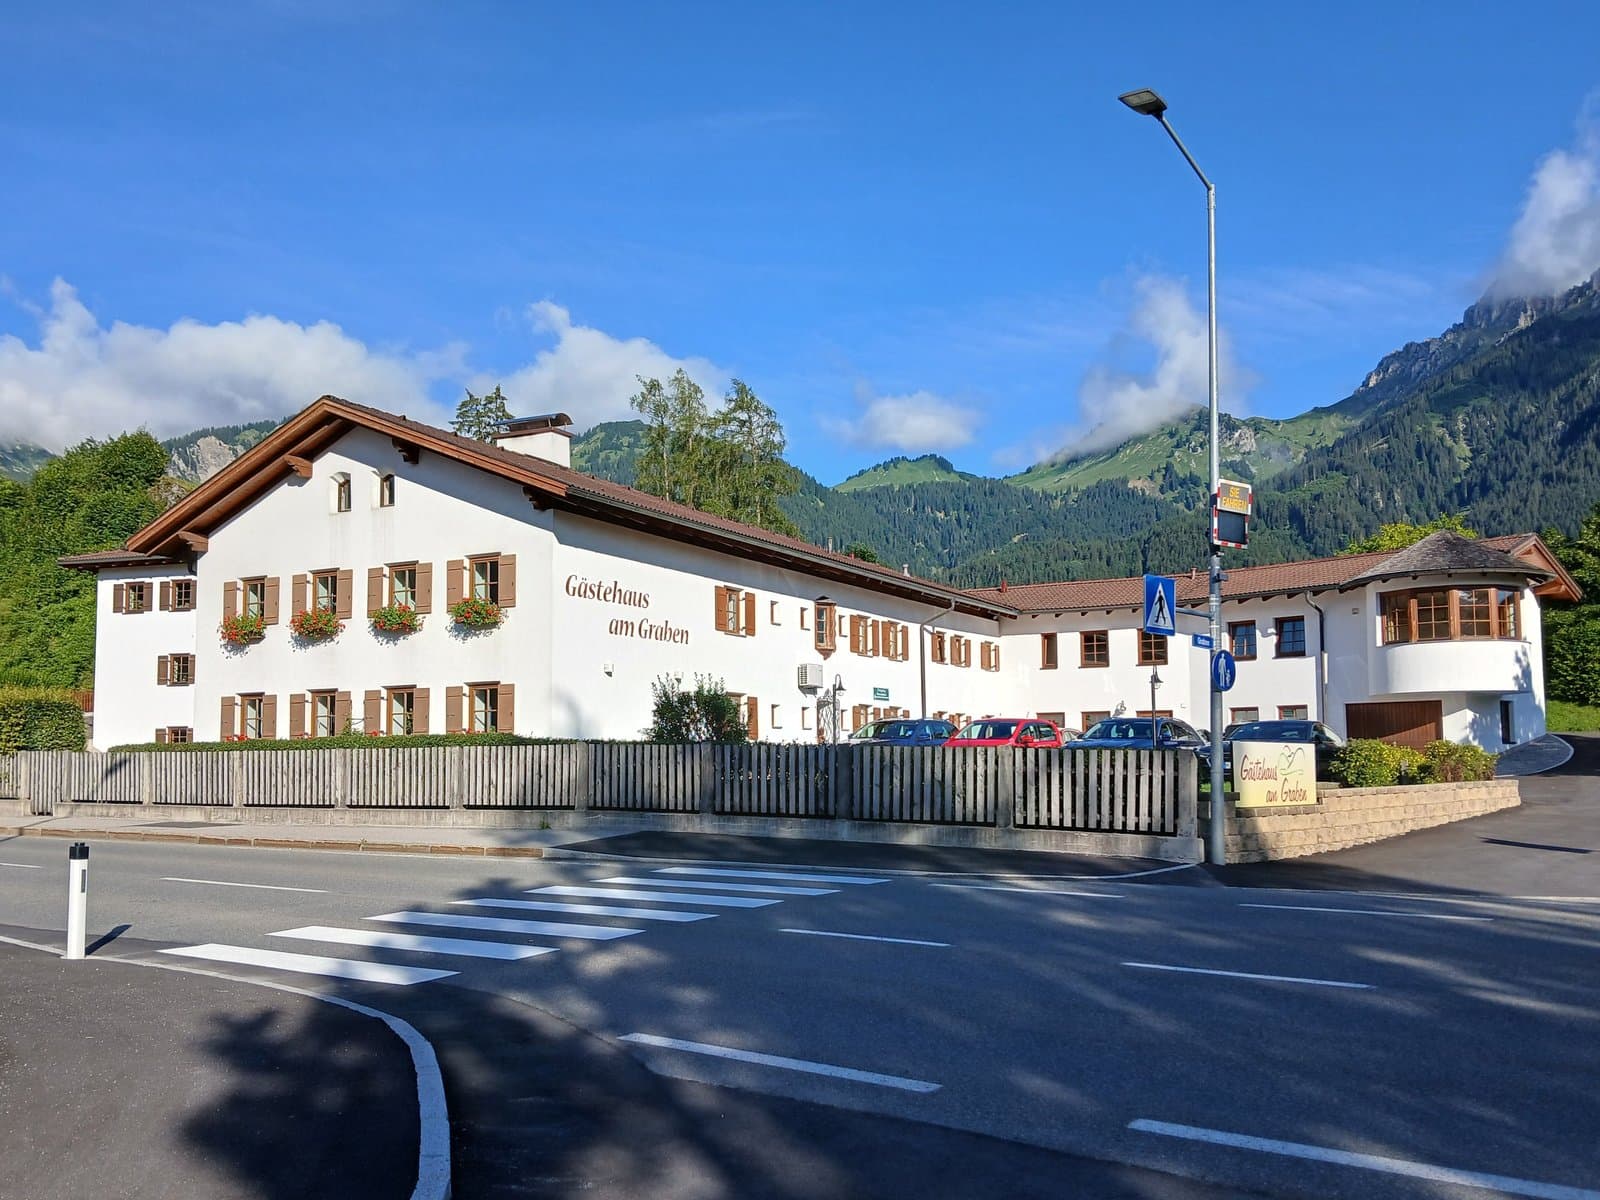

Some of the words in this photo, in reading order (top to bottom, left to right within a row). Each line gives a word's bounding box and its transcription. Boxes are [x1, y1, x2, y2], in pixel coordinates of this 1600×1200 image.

[565, 574, 650, 609] Gästehaus
[608, 618, 635, 637] am
[638, 618, 689, 645] Graben
[1240, 754, 1278, 781] Gästehaus
[1265, 790, 1278, 803] am
[1281, 777, 1307, 802] Graben
